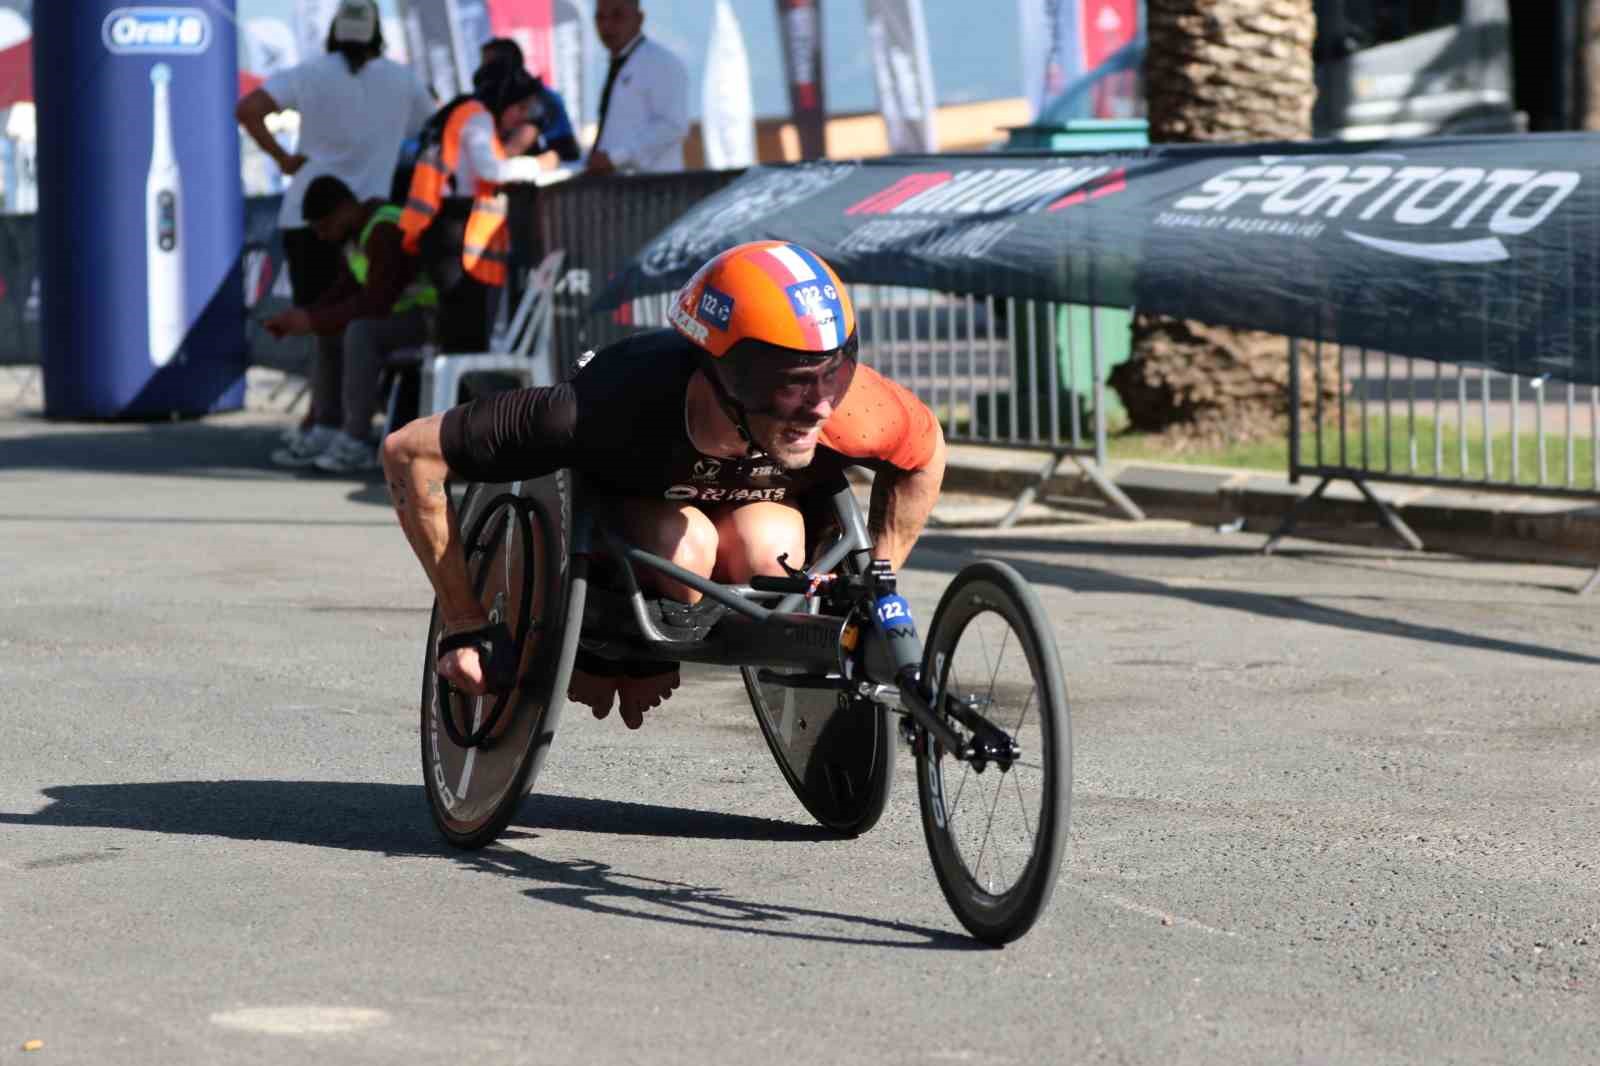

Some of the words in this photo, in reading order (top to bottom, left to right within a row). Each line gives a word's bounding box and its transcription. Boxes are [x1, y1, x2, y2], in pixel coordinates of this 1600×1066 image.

[702, 292, 719, 315] 122
[794, 285, 823, 306] 122
[877, 601, 904, 623] 122
